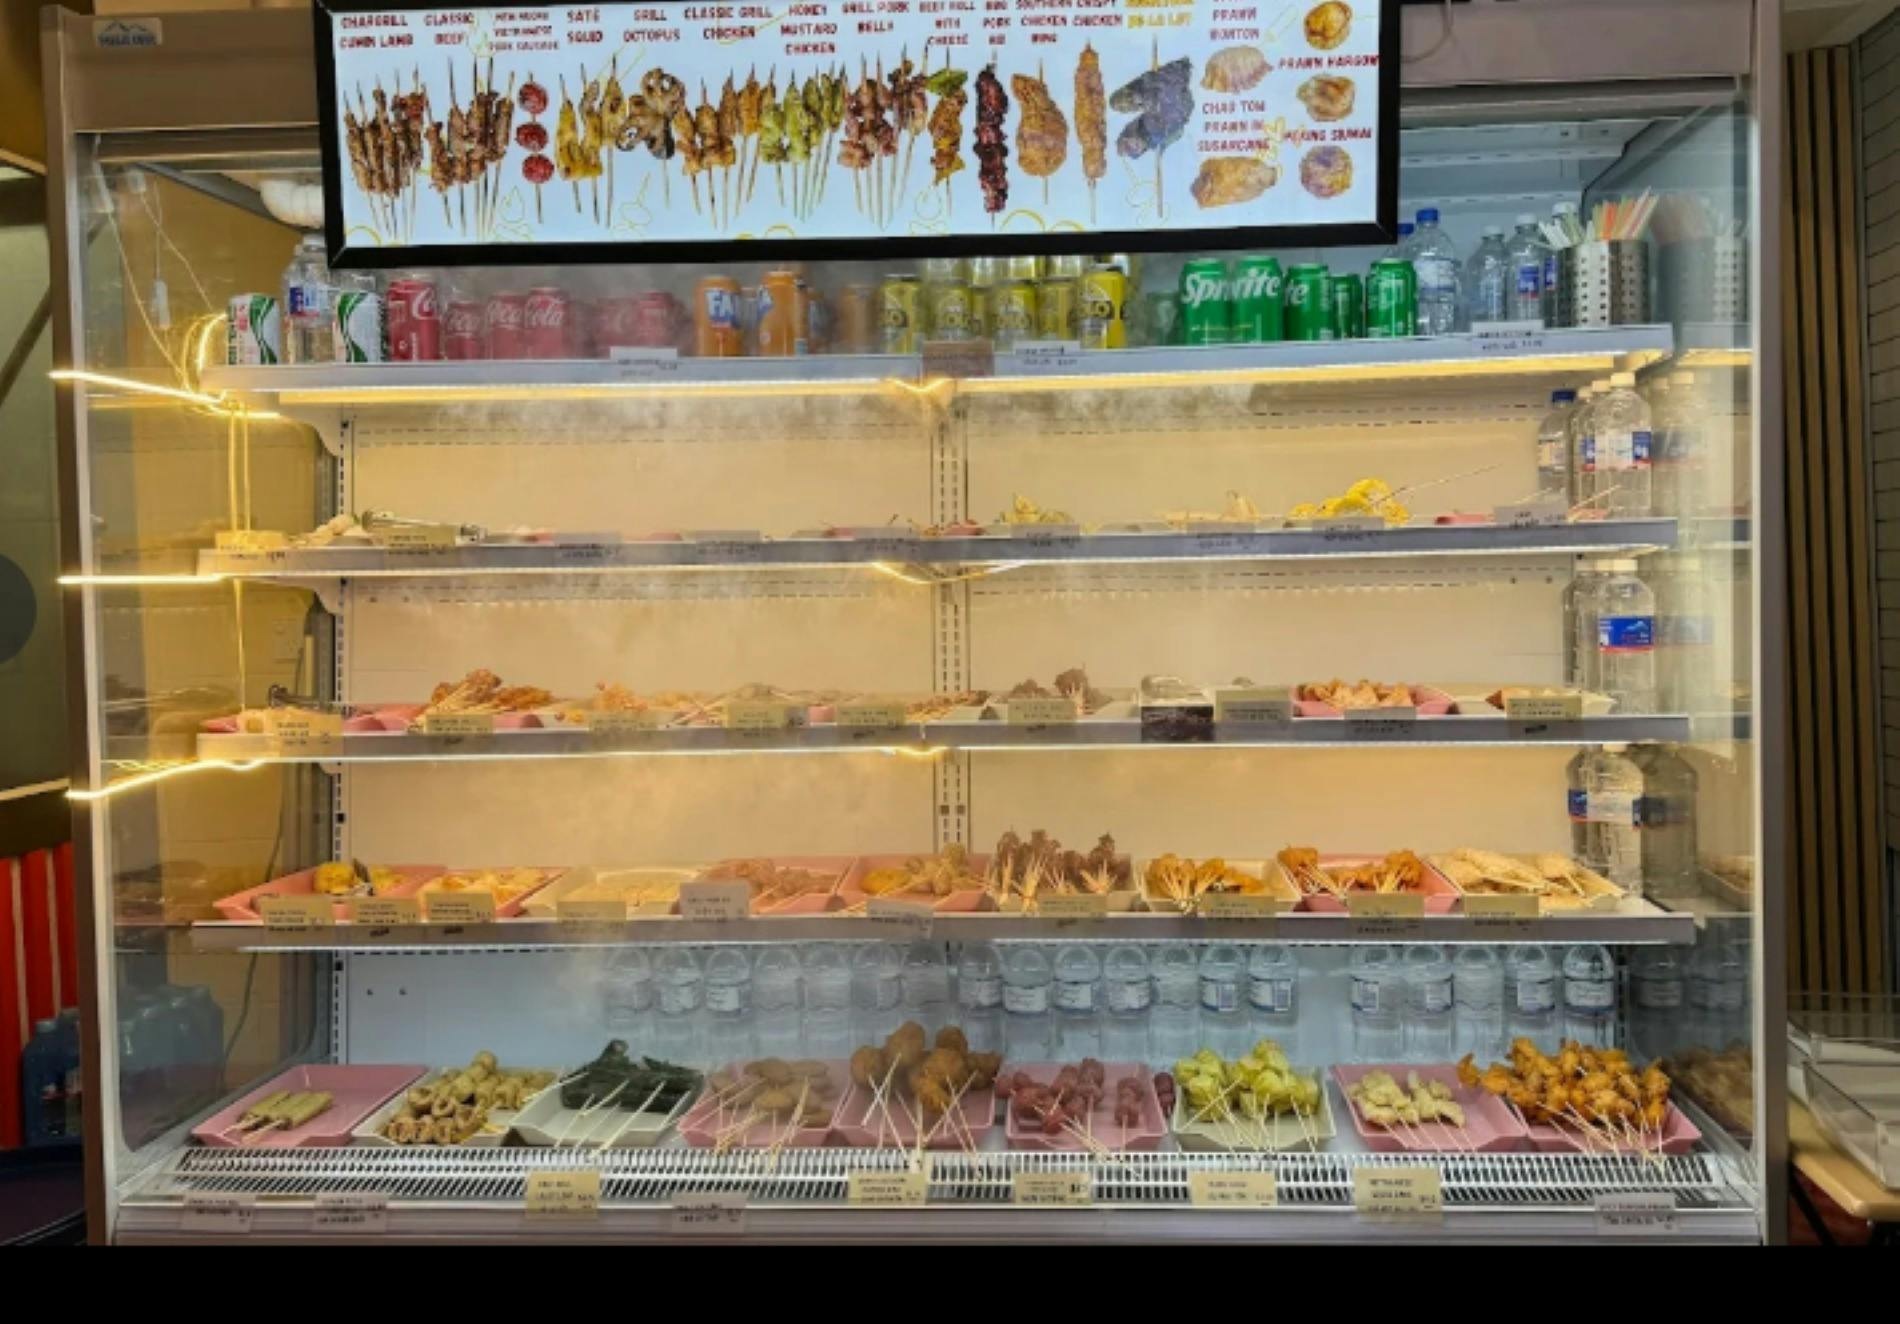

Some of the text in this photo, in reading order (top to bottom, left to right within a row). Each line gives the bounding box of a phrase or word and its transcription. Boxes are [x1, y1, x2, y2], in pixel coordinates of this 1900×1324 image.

[684, 6, 734, 20] CLASSIC
[623, 28, 681, 43] OCTOPUS
[703, 26, 755, 40] CHICKEN
[781, 23, 838, 36] MUSTARD
[785, 41, 836, 55] CHICKEN
